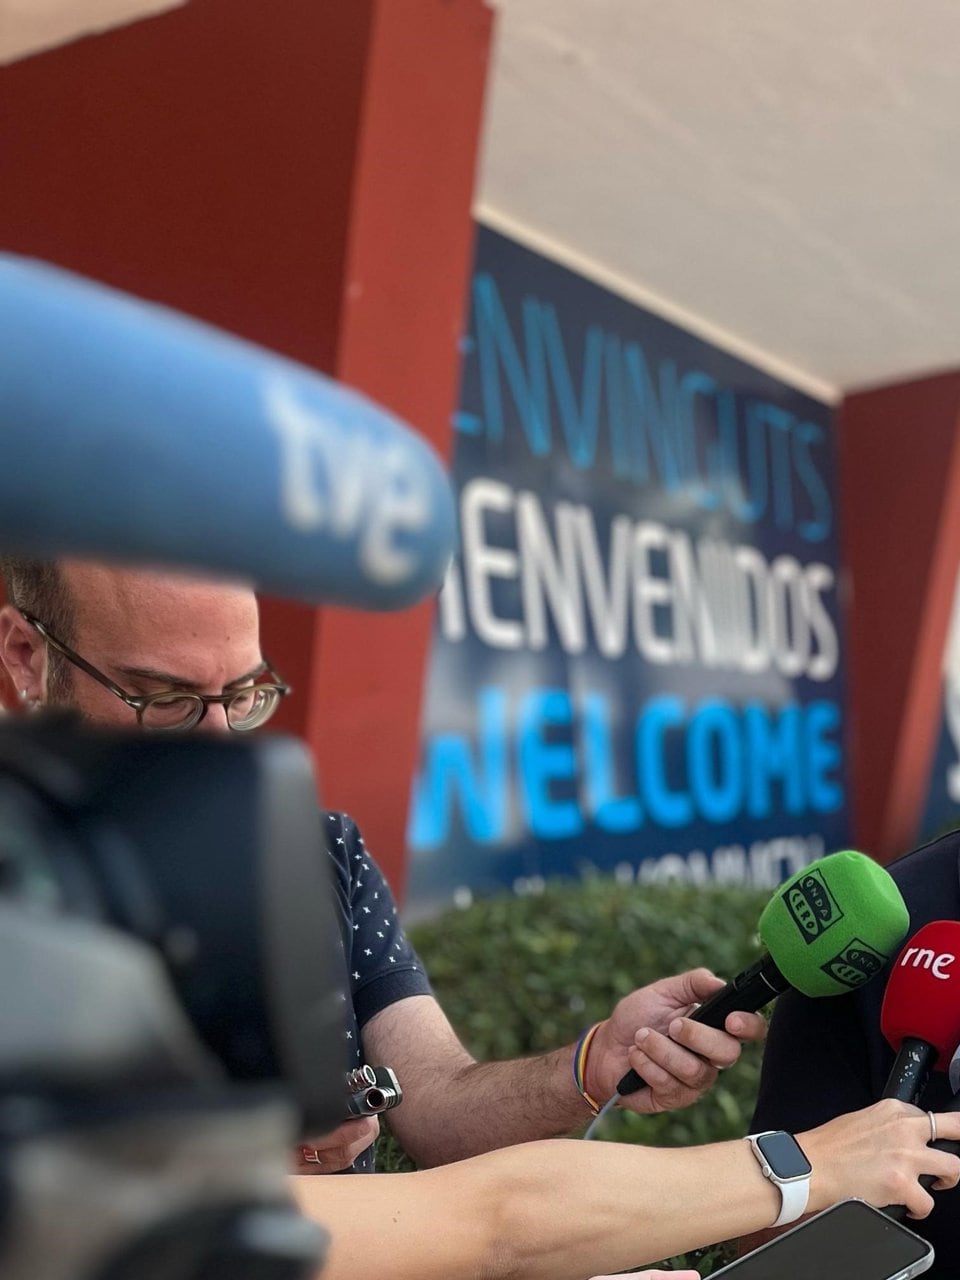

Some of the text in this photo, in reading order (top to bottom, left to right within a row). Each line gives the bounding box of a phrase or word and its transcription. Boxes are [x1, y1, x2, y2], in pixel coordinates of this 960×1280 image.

[449, 270, 833, 543] NVINGUTS
[258, 368, 434, 587] tve
[791, 892, 816, 930] CERO
[805, 879, 830, 918] ONDA
[900, 947, 956, 980] rne
